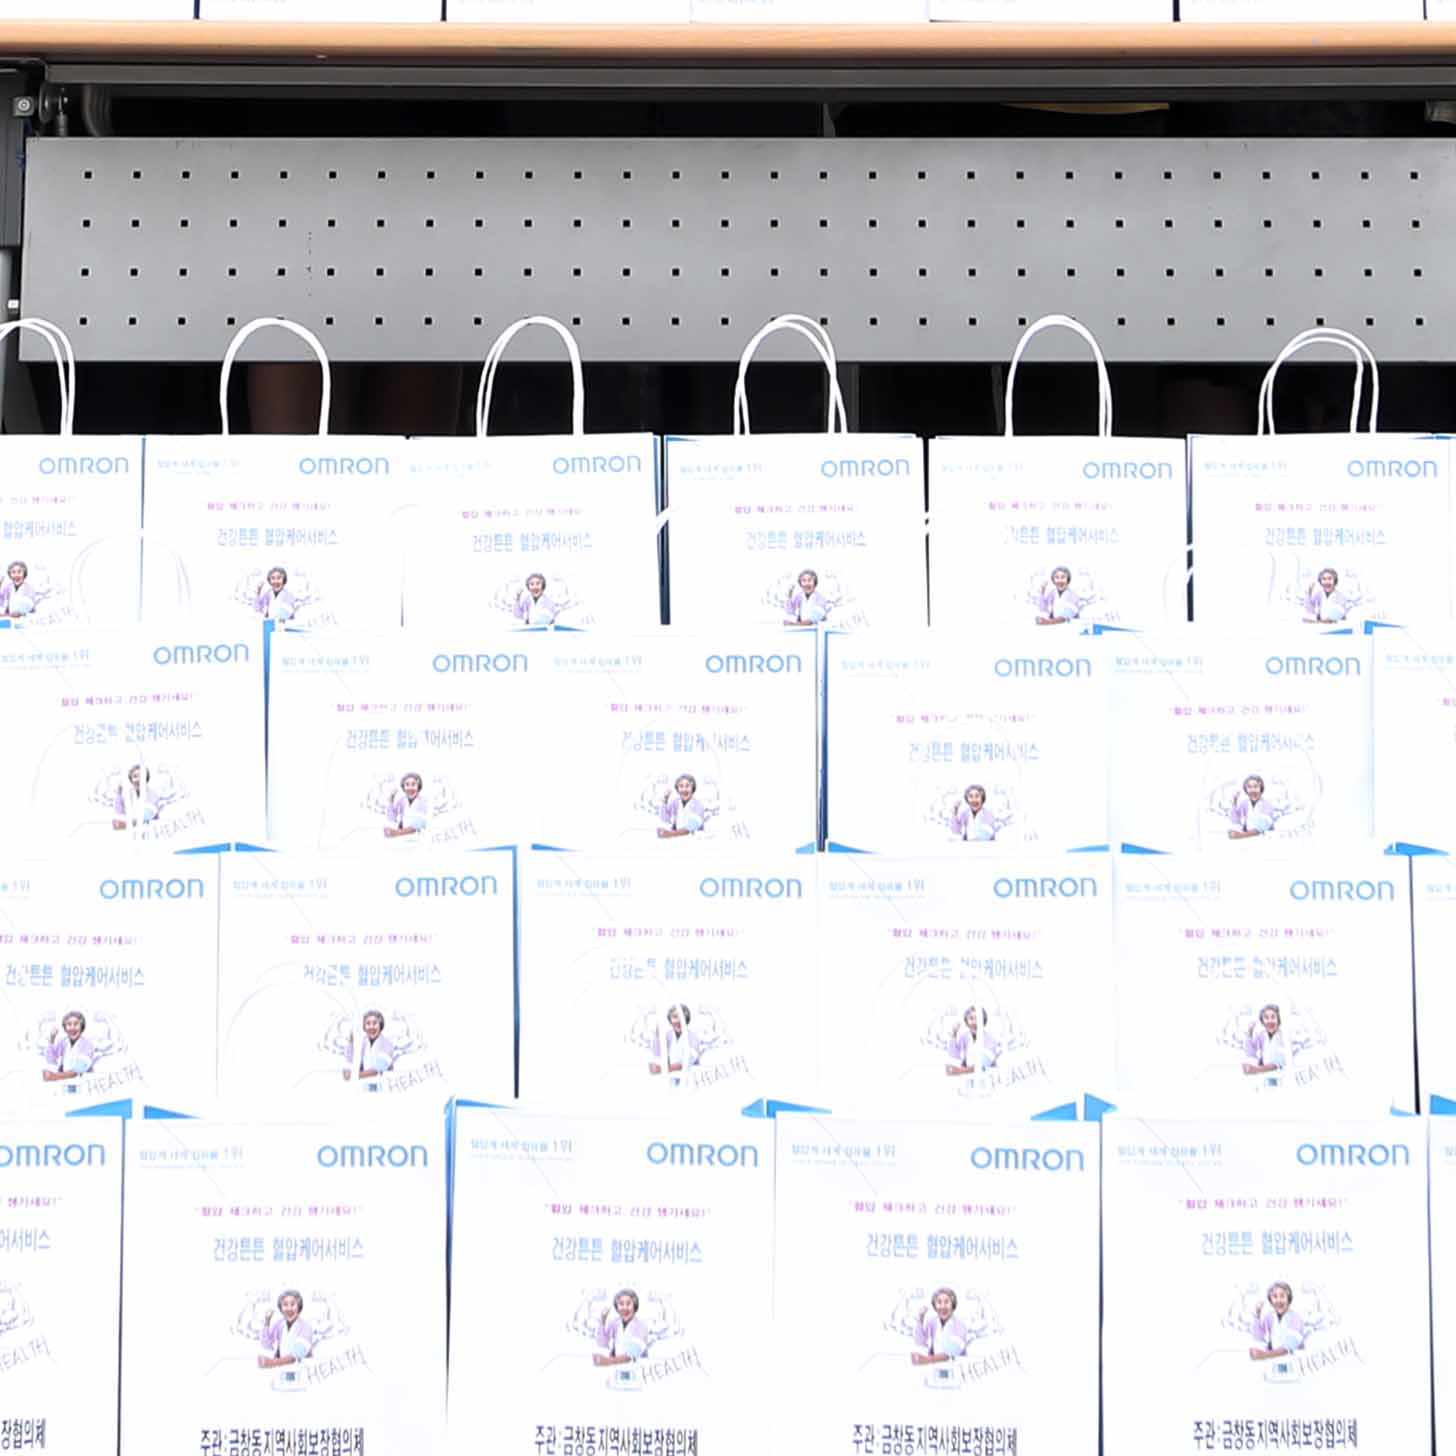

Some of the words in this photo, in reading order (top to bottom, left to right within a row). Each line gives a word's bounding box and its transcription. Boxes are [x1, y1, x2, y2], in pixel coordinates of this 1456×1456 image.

[38, 456, 129, 476] OMRON
[298, 456, 390, 476] OMRON
[552, 455, 642, 476] OMRON
[820, 458, 911, 480] OMRON
[1082, 460, 1173, 481] OMRON
[1346, 459, 1439, 479] OMRON
[152, 642, 250, 667] OMRON
[431, 653, 529, 673] OMRON
[704, 653, 803, 674] OMRON
[1264, 655, 1361, 677] OMRON
[993, 657, 1092, 678] OMRON
[98, 877, 205, 901] OMRON
[394, 874, 499, 898] OMRON
[698, 876, 803, 900] OMRON
[992, 875, 1099, 900] OMRON
[1289, 879, 1395, 902] OMRON
[315, 1143, 429, 1169] OMRON
[645, 1140, 759, 1168] OMRON
[969, 1145, 1085, 1173] OMRON
[1295, 1142, 1411, 1168] OMRON
[213, 1236, 265, 1263] 건강튼튼
[272, 1236, 364, 1263] 혈압케어서비스
[551, 1236, 605, 1263] 건강튼튼
[610, 1237, 703, 1265] 혈압케어서비스
[865, 1232, 919, 1259] 건강튼튼
[926, 1233, 1020, 1261] 혈압케어서비스
[1201, 1231, 1254, 1257] 건강튼튼
[1260, 1229, 1355, 1256] 혈압케어서비스
